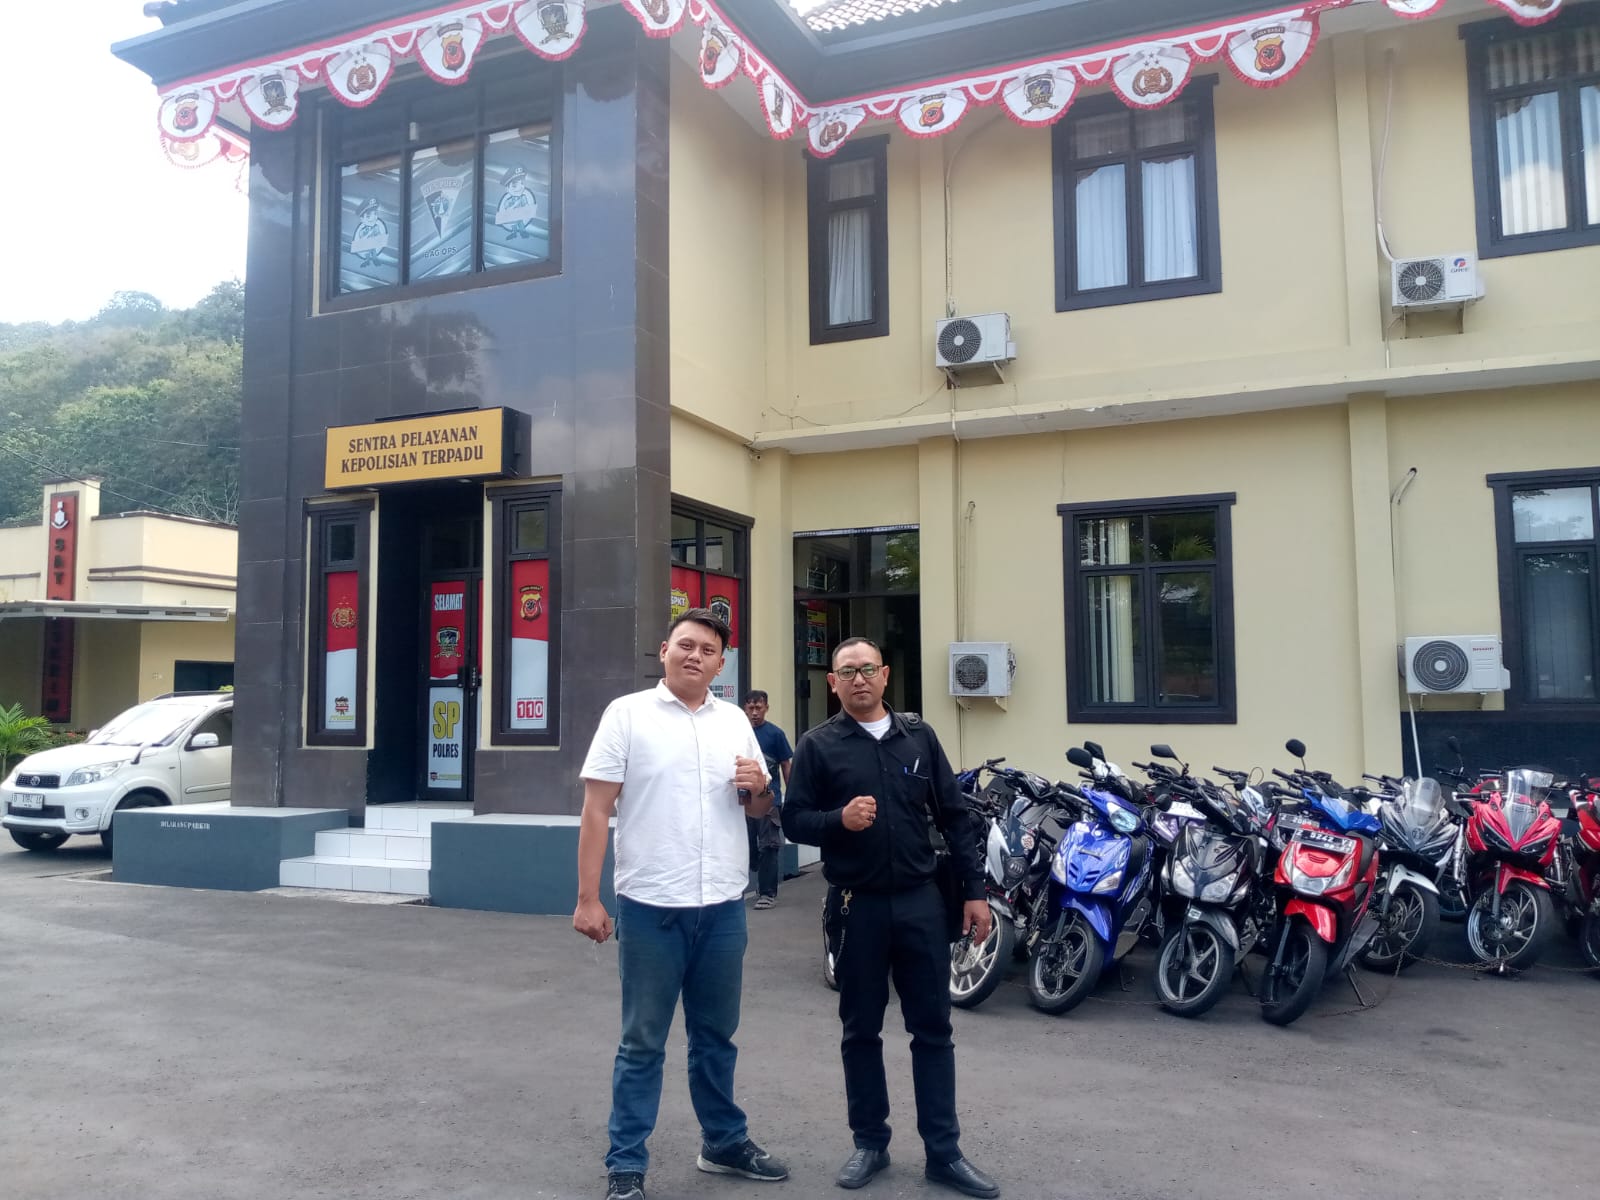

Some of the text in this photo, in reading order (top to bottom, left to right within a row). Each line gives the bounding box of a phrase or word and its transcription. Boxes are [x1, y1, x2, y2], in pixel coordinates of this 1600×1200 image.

[441, 246, 457, 255] OPS
[349, 425, 478, 453] SENTRA PELAYANAN
[341, 445, 483, 473] KEPOLISIAN TERPADU
[434, 593, 464, 611] SELAMAT
[518, 703, 543, 717] 110
[433, 701, 460, 739] SP
[432, 743, 459, 758] POLRES
